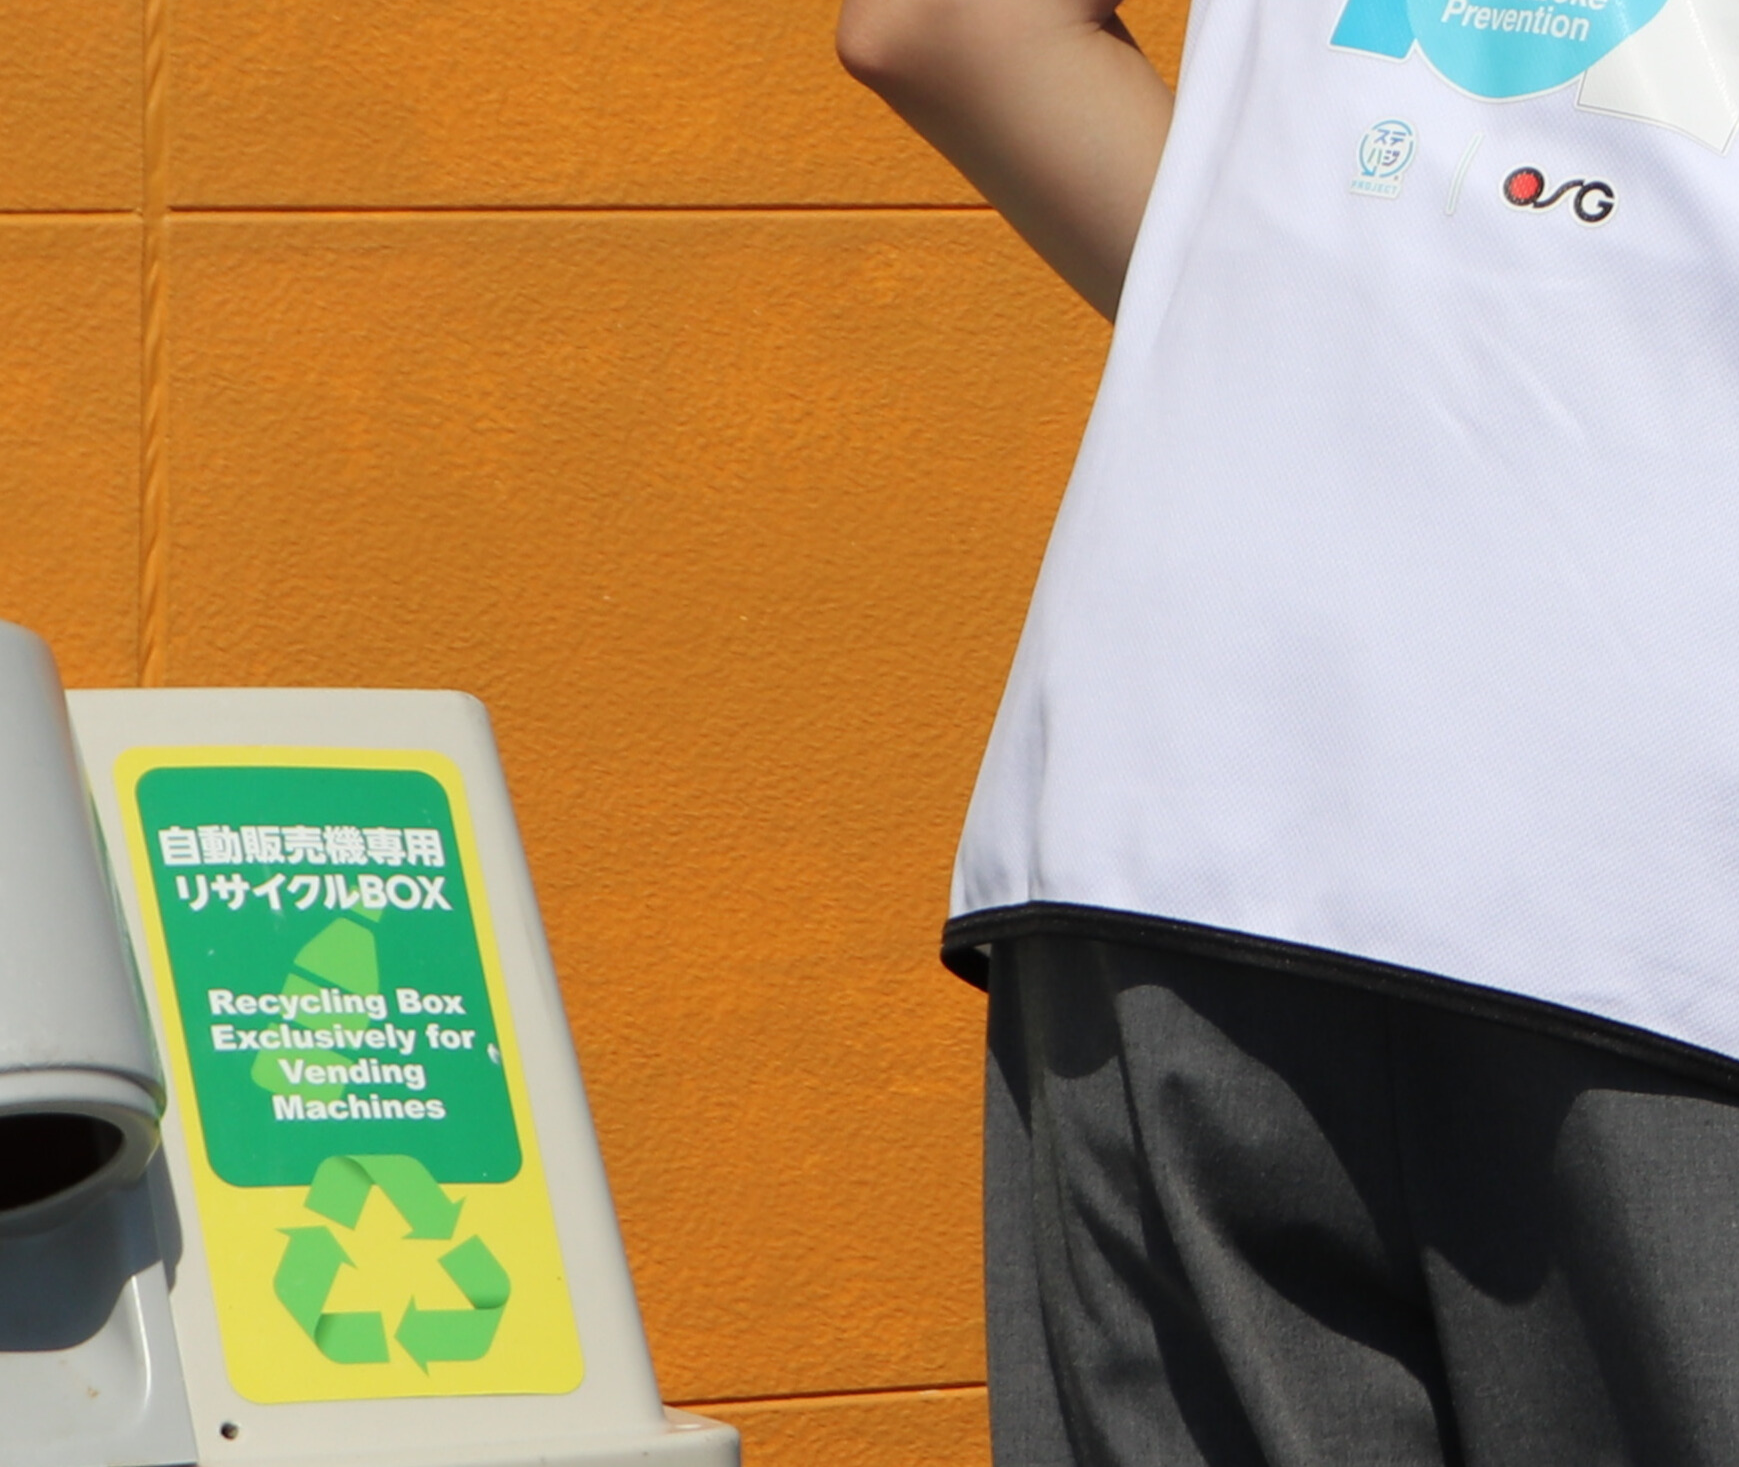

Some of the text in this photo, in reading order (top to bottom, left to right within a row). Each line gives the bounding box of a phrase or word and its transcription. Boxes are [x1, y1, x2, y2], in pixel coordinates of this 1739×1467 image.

[1350, 179, 1399, 196] PROJECT
[158, 825, 446, 867] 自動販売機専用
[175, 872, 453, 911] リサイクルBOX
[208, 987, 467, 1021] Recycling Box
[210, 1023, 476, 1056] Exclusively for
[277, 1057, 427, 1091] Vending
[272, 1093, 447, 1121] Machines
